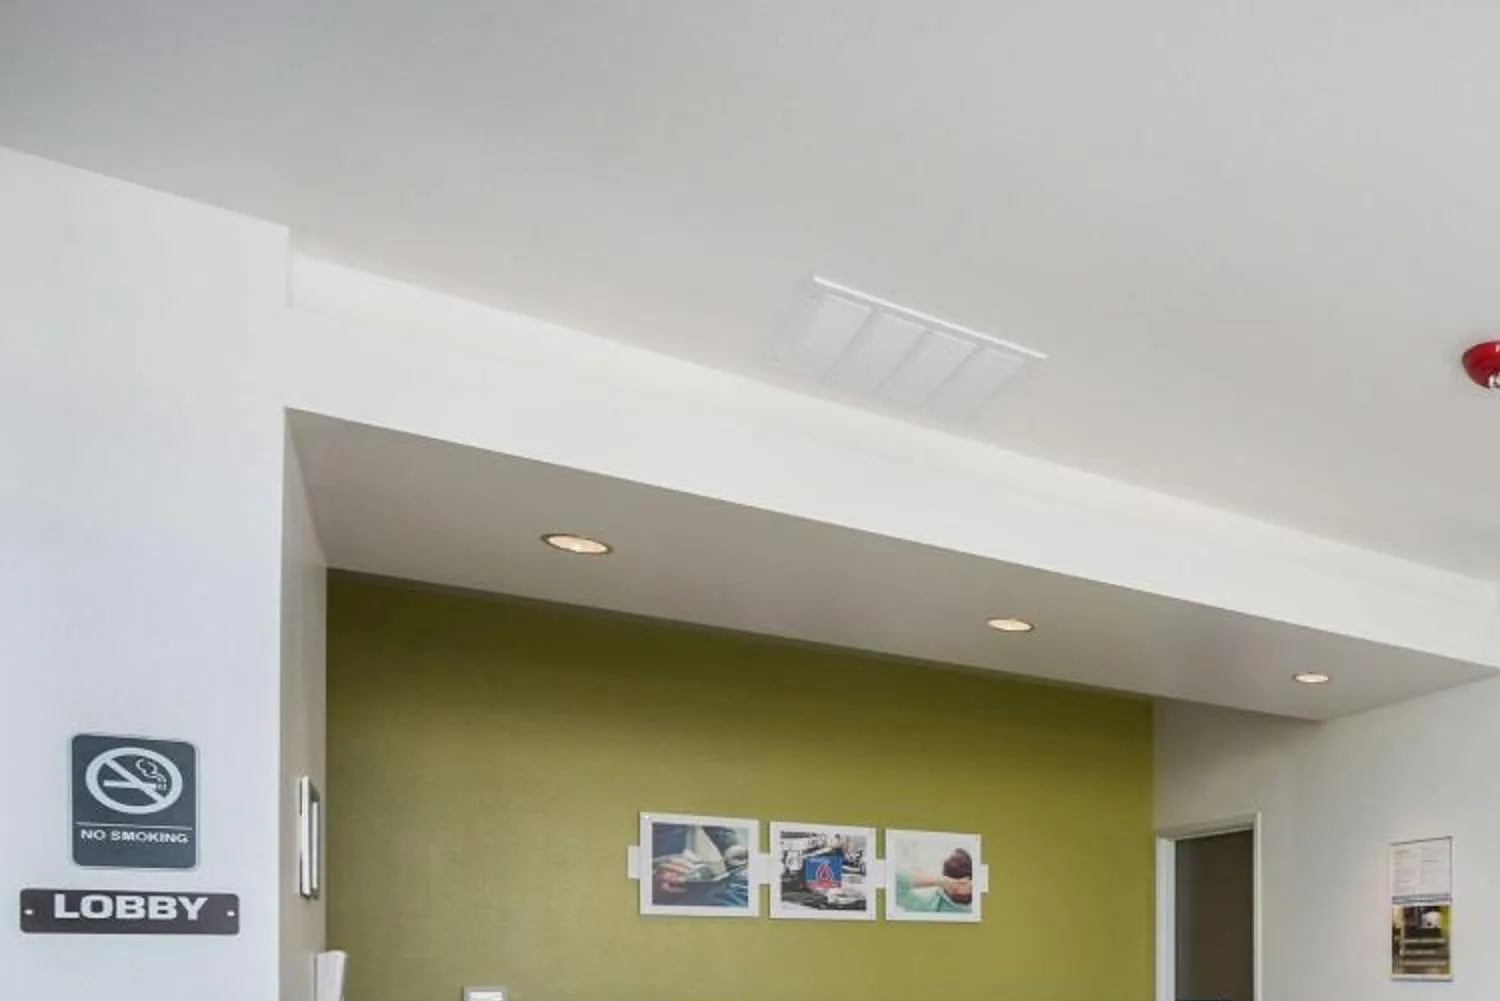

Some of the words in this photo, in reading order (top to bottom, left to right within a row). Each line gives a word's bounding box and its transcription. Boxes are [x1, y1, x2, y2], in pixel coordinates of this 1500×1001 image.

[81, 829, 106, 840] NO
[111, 830, 189, 843] SMOKING
[54, 893, 209, 921] LOBBY
